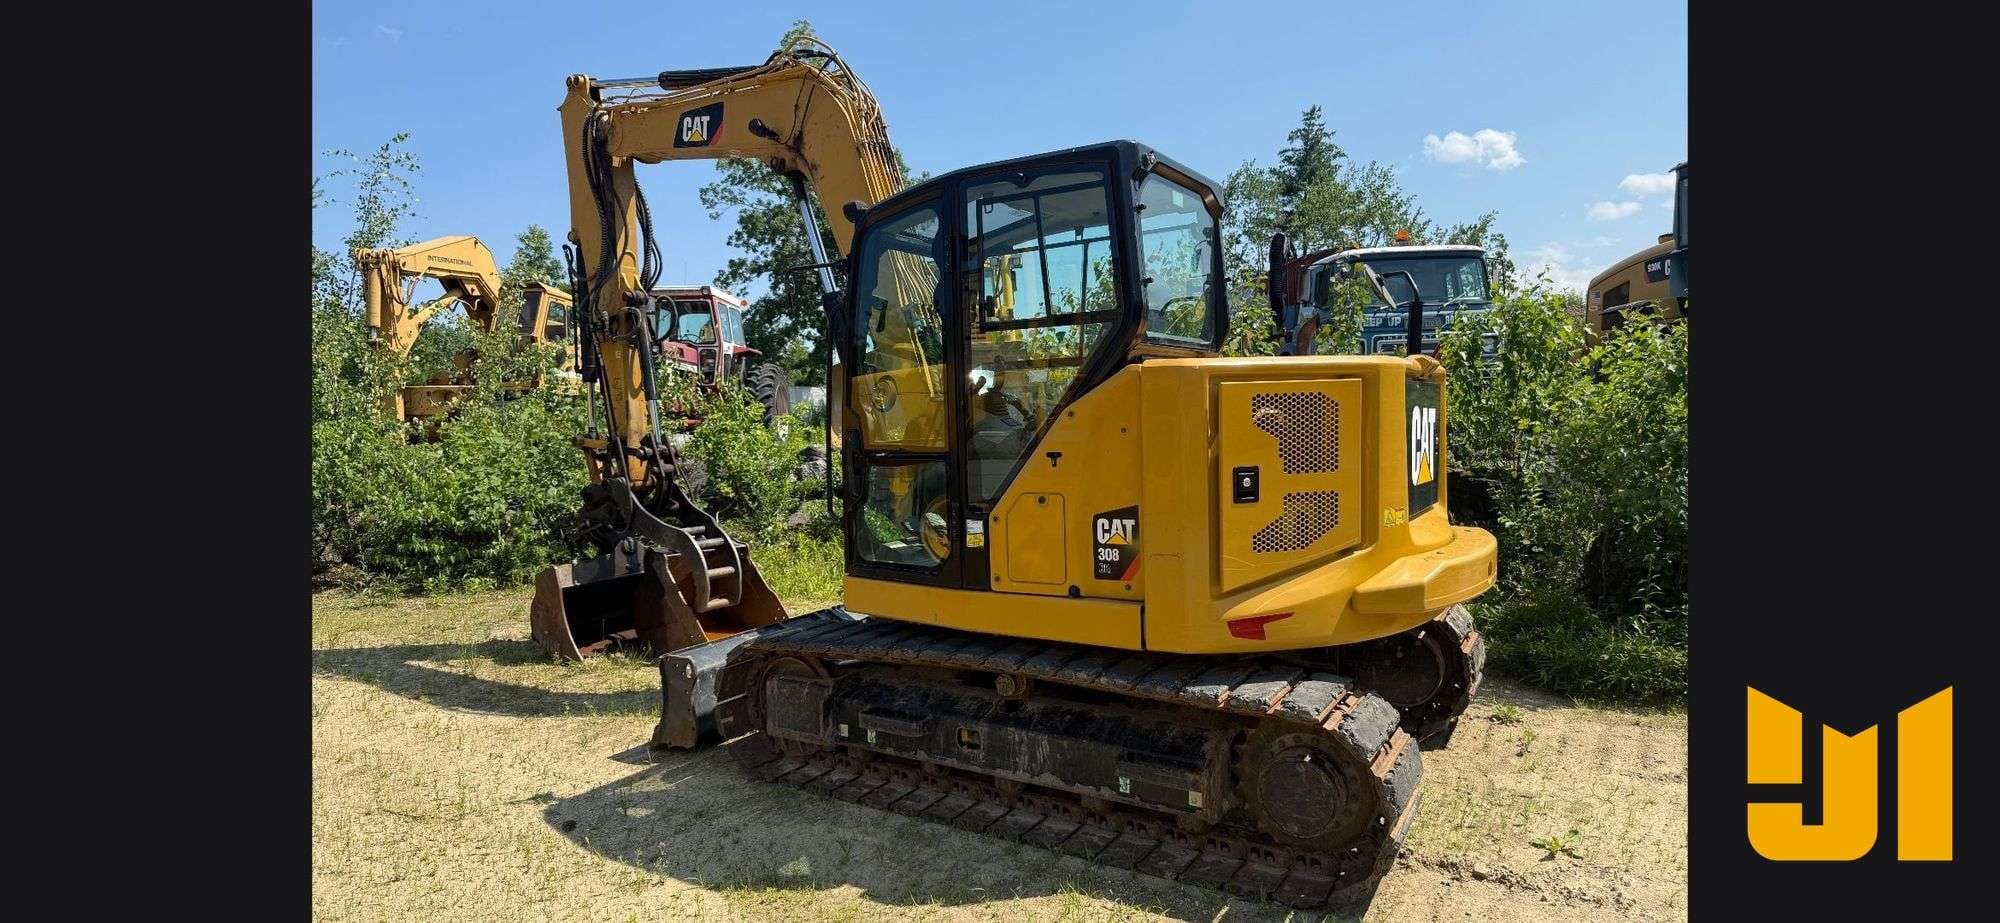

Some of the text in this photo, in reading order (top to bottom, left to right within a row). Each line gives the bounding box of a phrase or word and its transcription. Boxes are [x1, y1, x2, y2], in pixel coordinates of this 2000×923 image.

[683, 115, 710, 142] CAT
[427, 255, 473, 266] INTERNATIONAL
[1387, 316, 1402, 327] UP
[1411, 405, 1436, 486] CAT
[1097, 518, 1135, 544] CAT
[1098, 547, 1120, 561] 308
